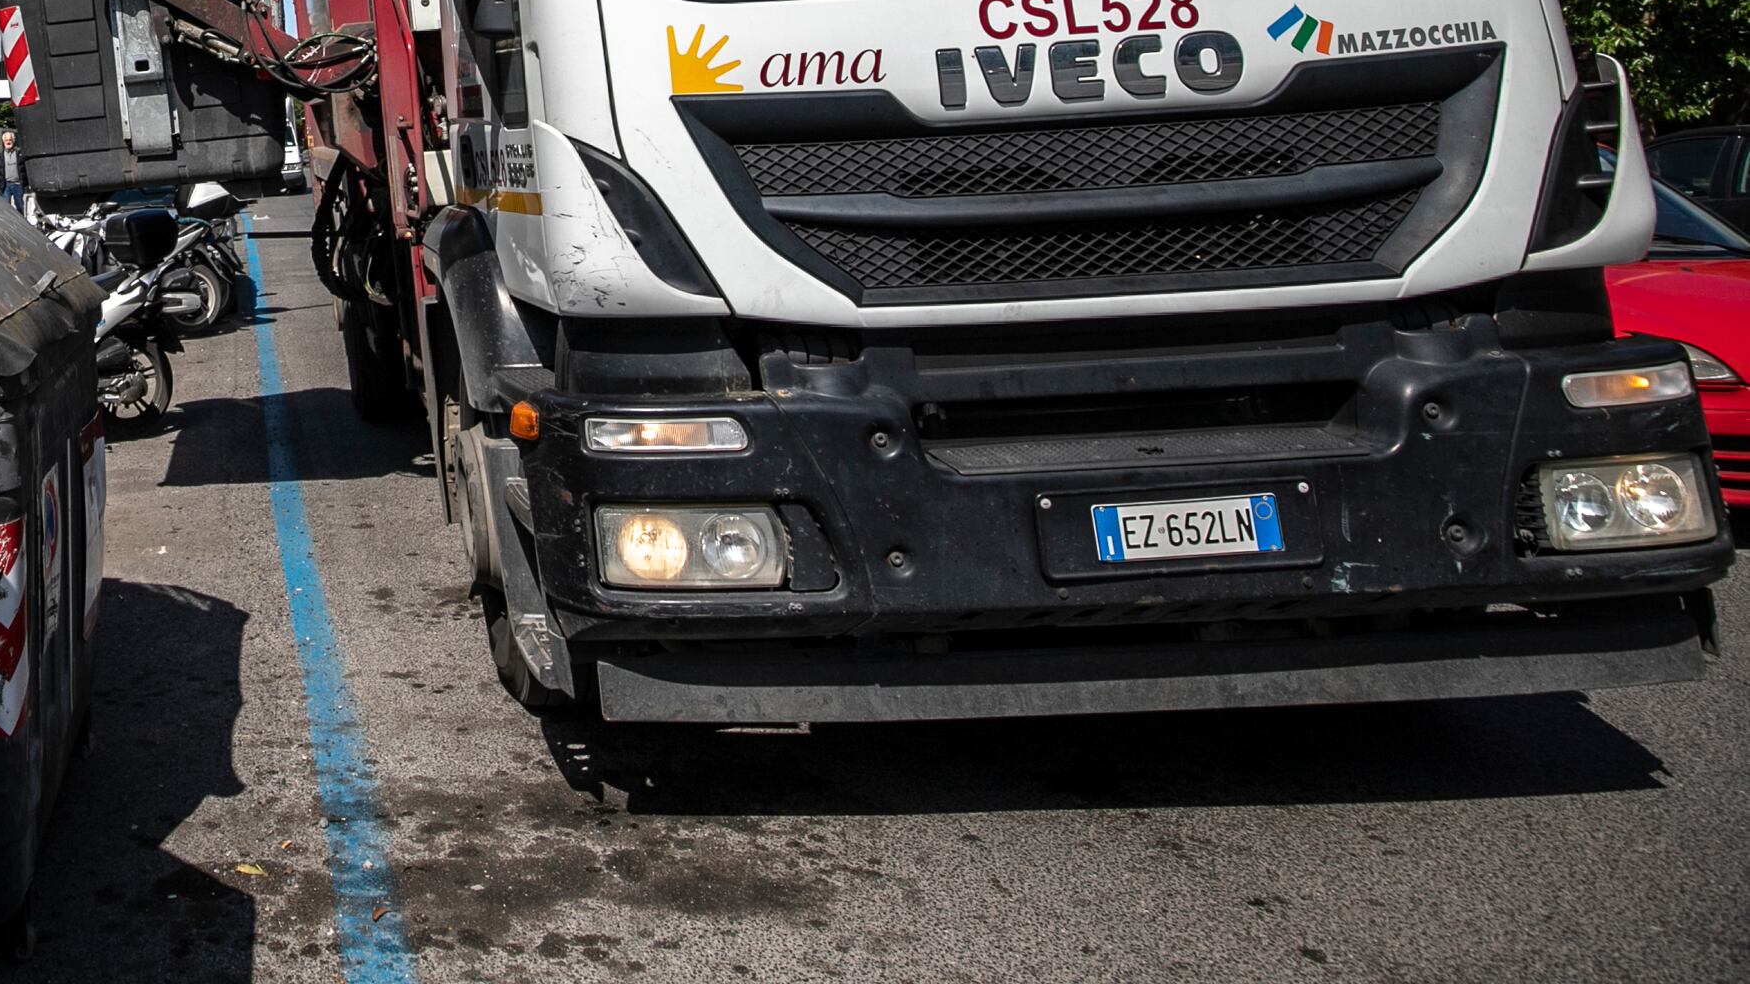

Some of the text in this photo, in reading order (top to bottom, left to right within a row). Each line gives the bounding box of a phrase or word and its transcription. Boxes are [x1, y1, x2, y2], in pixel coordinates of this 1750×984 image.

[1337, 20, 1497, 54] MAZZOCCHIA
[759, 48, 887, 88] ama
[935, 30, 1244, 111] IVECO
[1122, 508, 1255, 549] EZ 652LN
